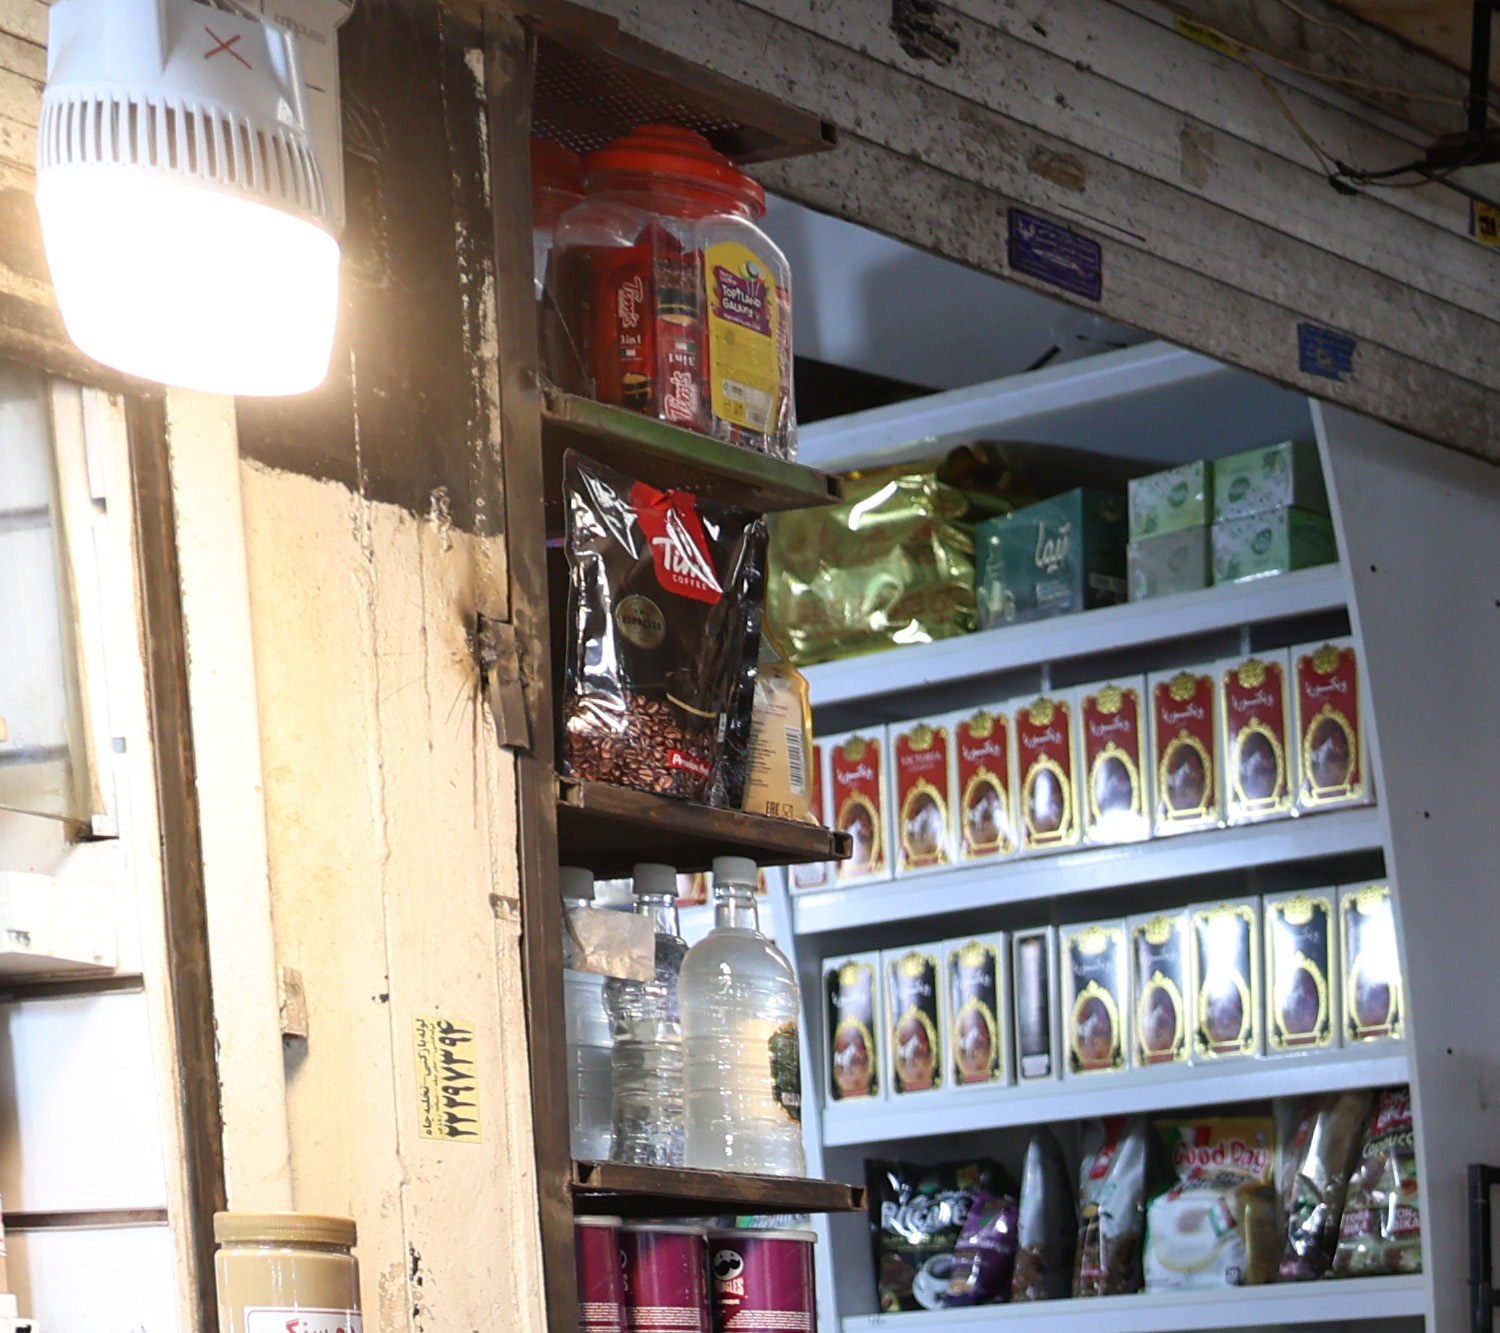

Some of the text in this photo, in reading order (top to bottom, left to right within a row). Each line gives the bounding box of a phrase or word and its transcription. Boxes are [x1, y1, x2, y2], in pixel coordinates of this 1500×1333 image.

[672, 574, 708, 591] COFFEE
[436, 1018, 479, 1138] ۲۲۲۹۷۳۹۴
[1173, 1139, 1270, 1176] Good Day
